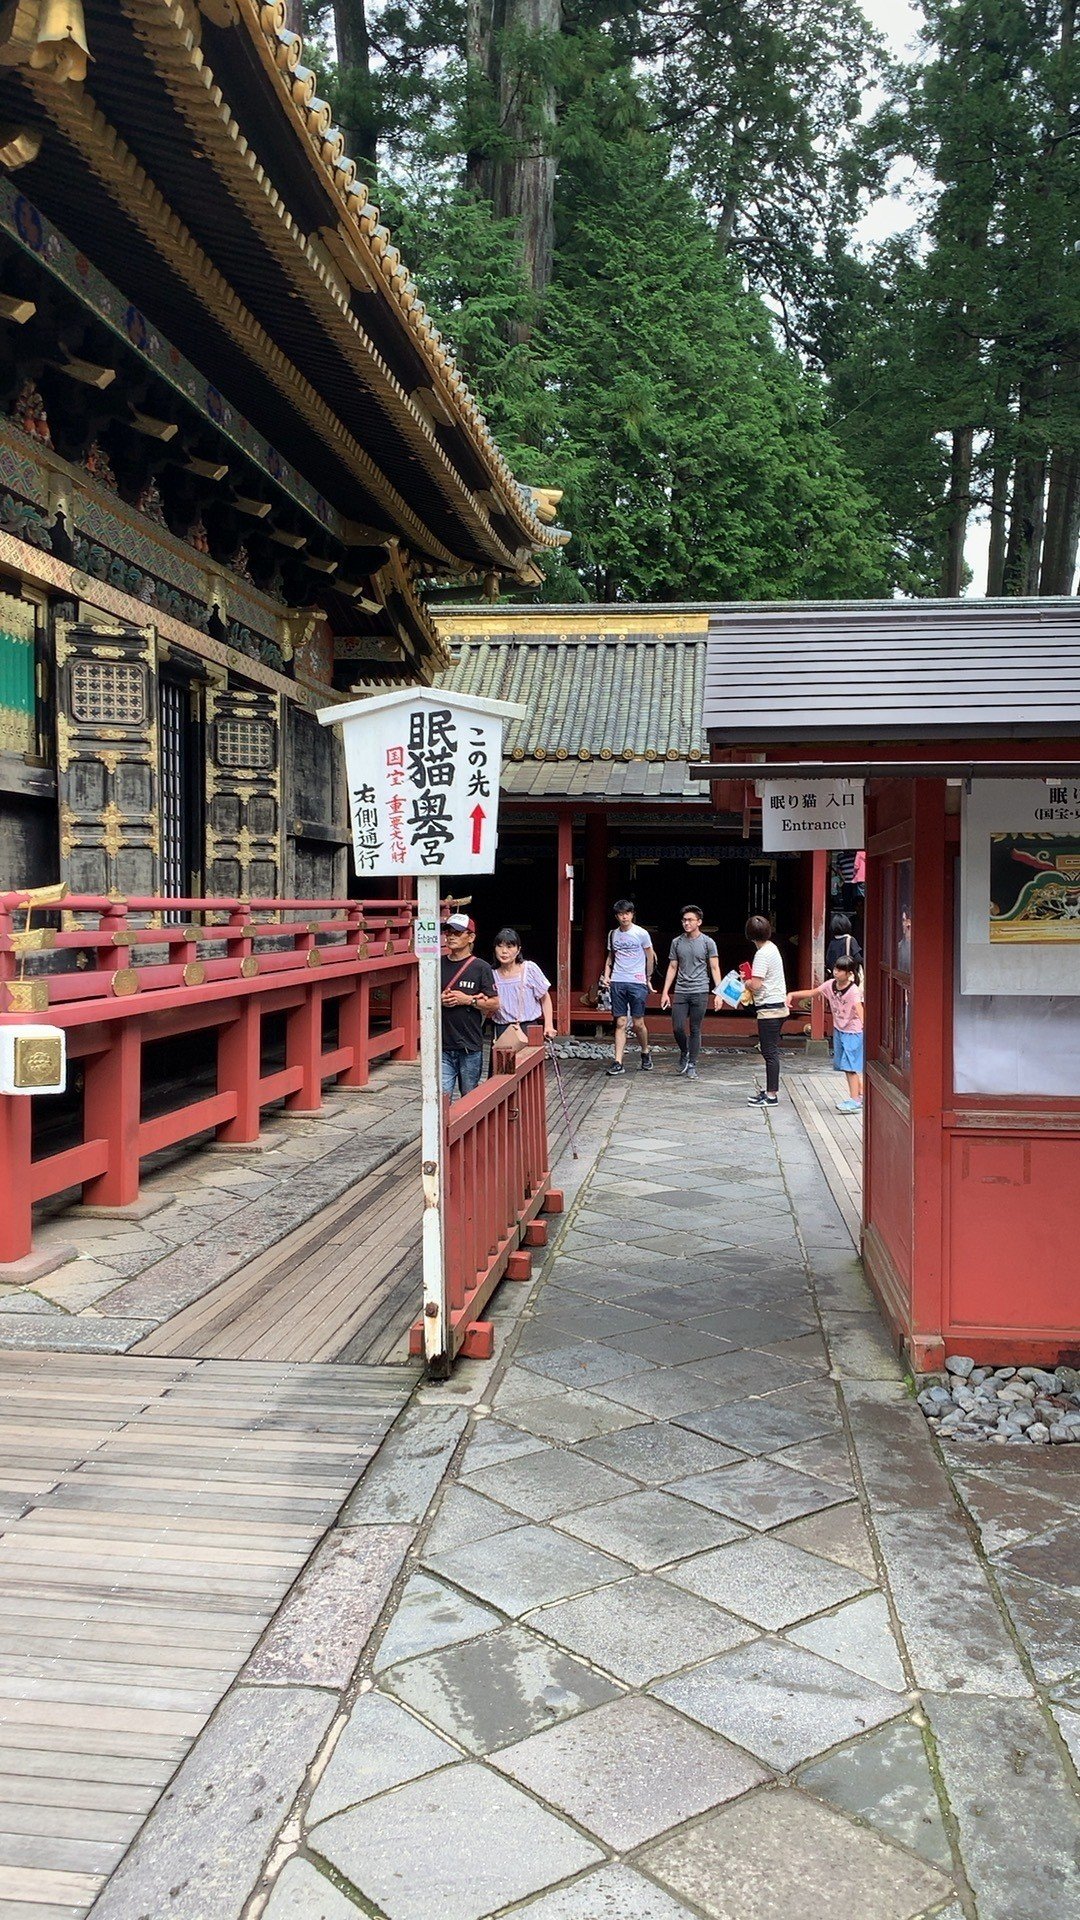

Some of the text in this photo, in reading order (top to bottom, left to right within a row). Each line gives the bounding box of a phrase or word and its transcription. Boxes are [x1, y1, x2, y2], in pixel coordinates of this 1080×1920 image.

[407, 709, 458, 866] 眠猫奥宮
[466, 728, 490, 798] この先
[353, 783, 384, 870] 右側通行
[385, 746, 407, 864] 国宝 重要文化財
[770, 793, 855, 809] 眠り猫 入口
[782, 819, 847, 832] Entrance
[417, 922, 436, 931] 入口
